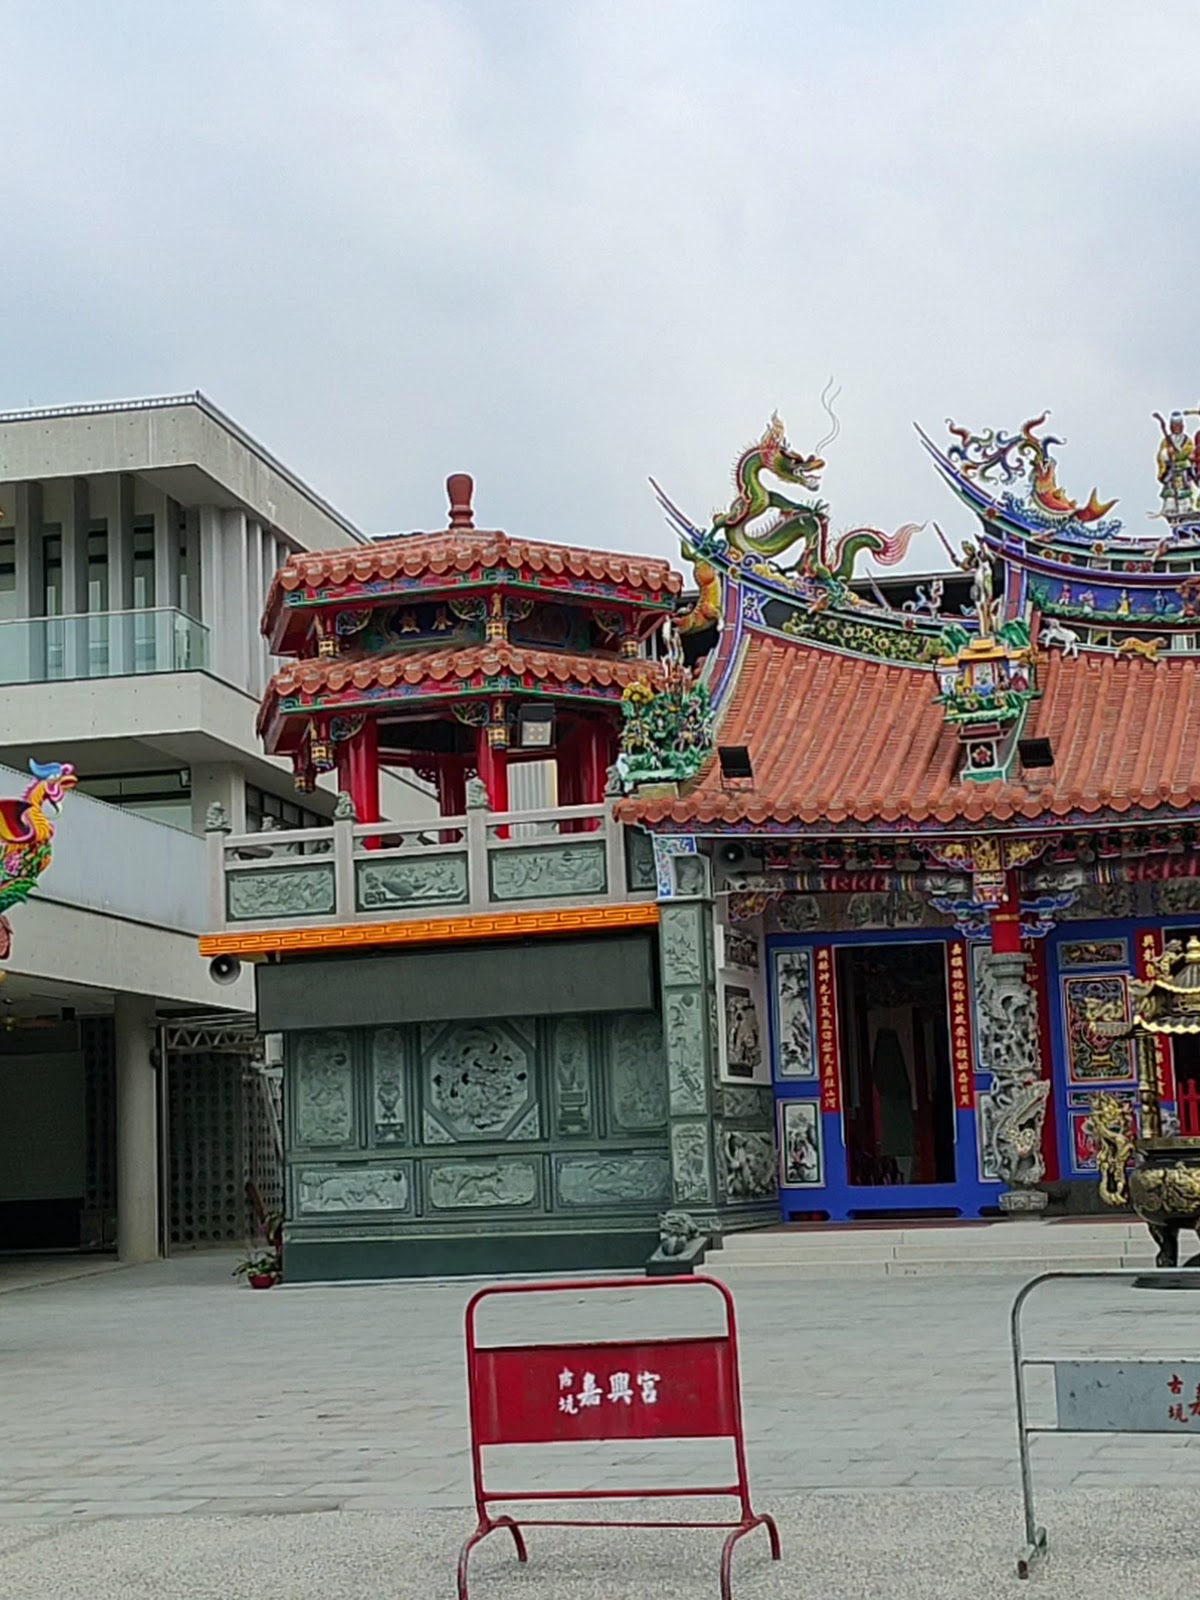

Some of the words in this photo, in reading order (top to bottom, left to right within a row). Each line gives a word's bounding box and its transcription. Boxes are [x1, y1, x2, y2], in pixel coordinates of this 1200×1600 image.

[558, 1367, 578, 1414] 古坑
[576, 1371, 661, 1406] 嘉興宮
[1167, 1374, 1188, 1423] 古坑
